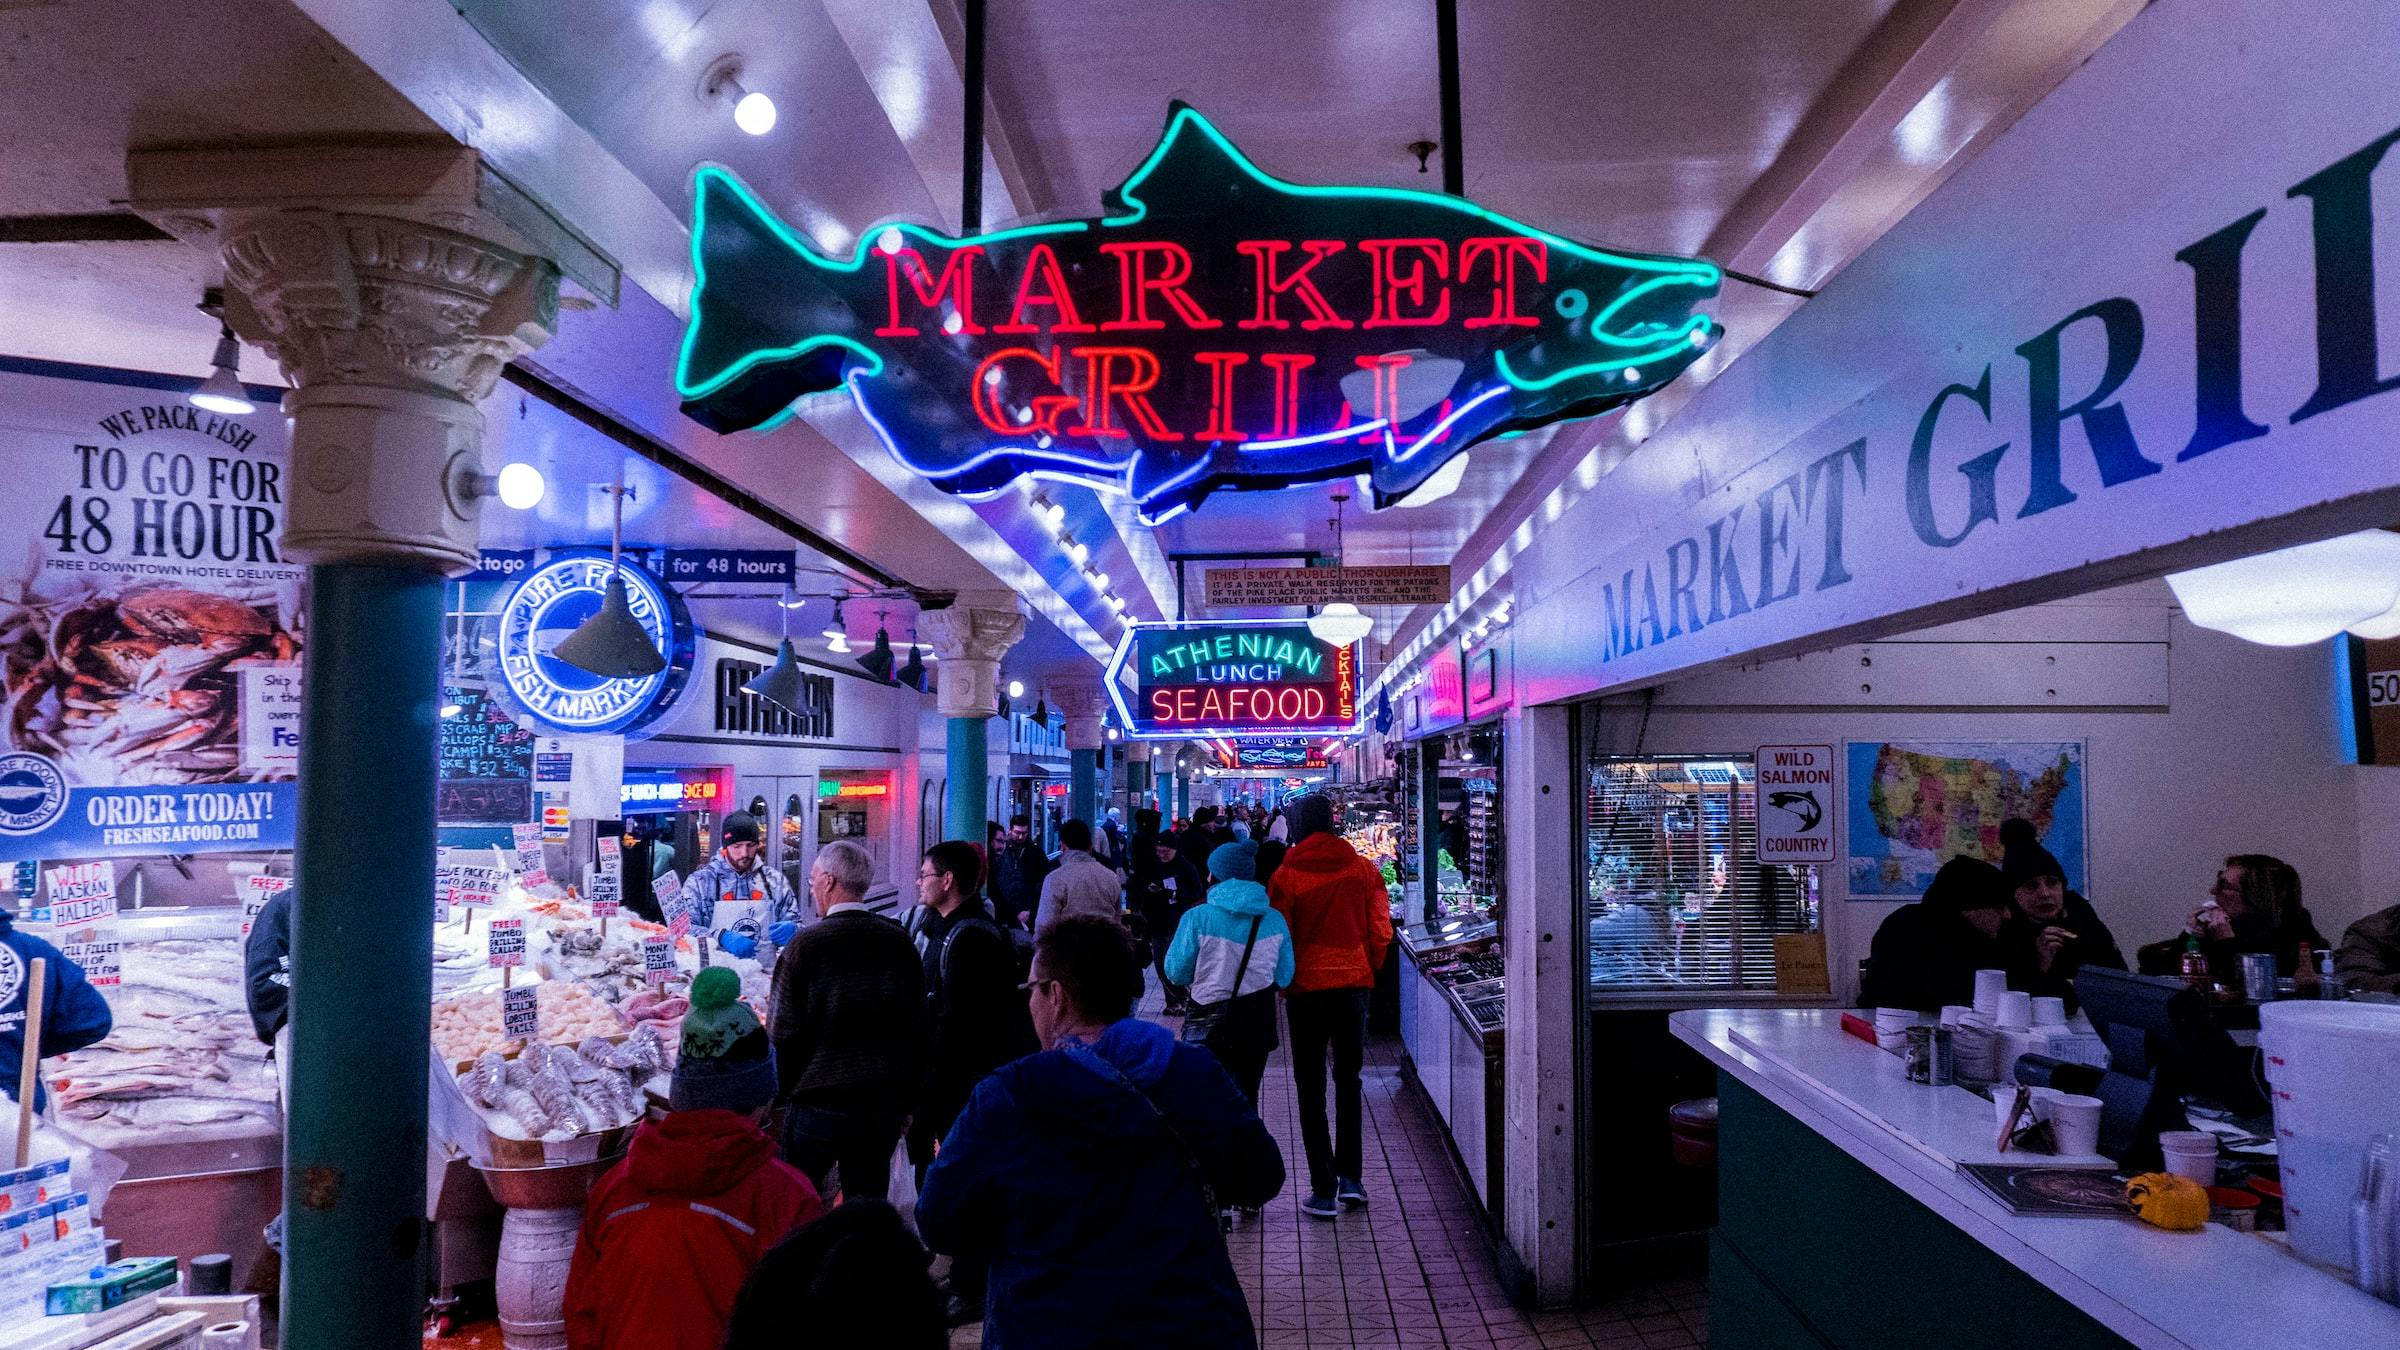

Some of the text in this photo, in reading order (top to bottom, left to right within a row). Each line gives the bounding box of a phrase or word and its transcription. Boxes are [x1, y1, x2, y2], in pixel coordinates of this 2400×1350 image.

[871, 238, 1549, 337] MARKET
[971, 345, 1454, 446] GRILL
[99, 404, 257, 453] WE PACK FISH
[73, 444, 282, 503] TO GO FOR
[43, 495, 297, 565] 48 HOUR
[1601, 437, 1868, 664] MARKET
[46, 559, 84, 571] FREE
[89, 561, 182, 576] DOWNTOWN
[186, 566, 232, 579] HOTEL
[484, 556, 502, 571] to
[503, 559, 525, 574] go
[672, 557, 699, 573] for
[706, 558, 729, 573] 48
[737, 557, 787, 574] hours
[1213, 568, 1437, 580] THIS IS NOT A PUBLIC THOROUGHFARE
[1225, 581, 1233, 589] IS
[1403, 578, 1440, 586] PATRONS
[1268, 588, 1295, 596] PLACE
[1331, 587, 1370, 595] MARKETS
[1415, 585, 1432, 593] THE
[514, 565, 574, 629] PURE
[1212, 597, 1245, 605] FAIRLEY
[1152, 633, 1322, 679] ATHENIAN
[1196, 664, 1282, 682] LUNCH
[1339, 643, 1353, 719] CKTAILS
[264, 674, 291, 692] Ship
[507, 655, 551, 710] FISH
[261, 691, 275, 702] in
[1152, 688, 1324, 722] SEAFOOD
[456, 724, 487, 735] CRAB
[495, 724, 513, 734] MP
[1775, 752, 1814, 766] WILD
[23, 760, 57, 785] FOOD
[1762, 770, 1830, 784] SALMON
[9, 790, 57, 826] MARKET
[86, 791, 273, 827] ORDER TODAY!
[103, 823, 259, 846] FRESHSEAFOOD.COM
[1766, 838, 1828, 852] COUNTRY
[53, 863, 102, 887] WILD
[463, 867, 485, 878] PACK
[486, 869, 510, 880] FISH
[51, 879, 107, 902] ALASKAN
[250, 878, 284, 889] FRESH
[461, 879, 476, 889] GO
[480, 881, 499, 892] FOR
[56, 899, 114, 926] HALIBUT
[493, 920, 521, 928] FRESH
[490, 929, 522, 938] JUMBO
[85, 943, 119, 955] FILLET
[645, 944, 668, 954] MONK
[646, 954, 667, 962] FISH
[646, 960, 676, 970] FILLETS
[504, 1011, 537, 1025] LOBSTER
[507, 1025, 535, 1035] TAILS
